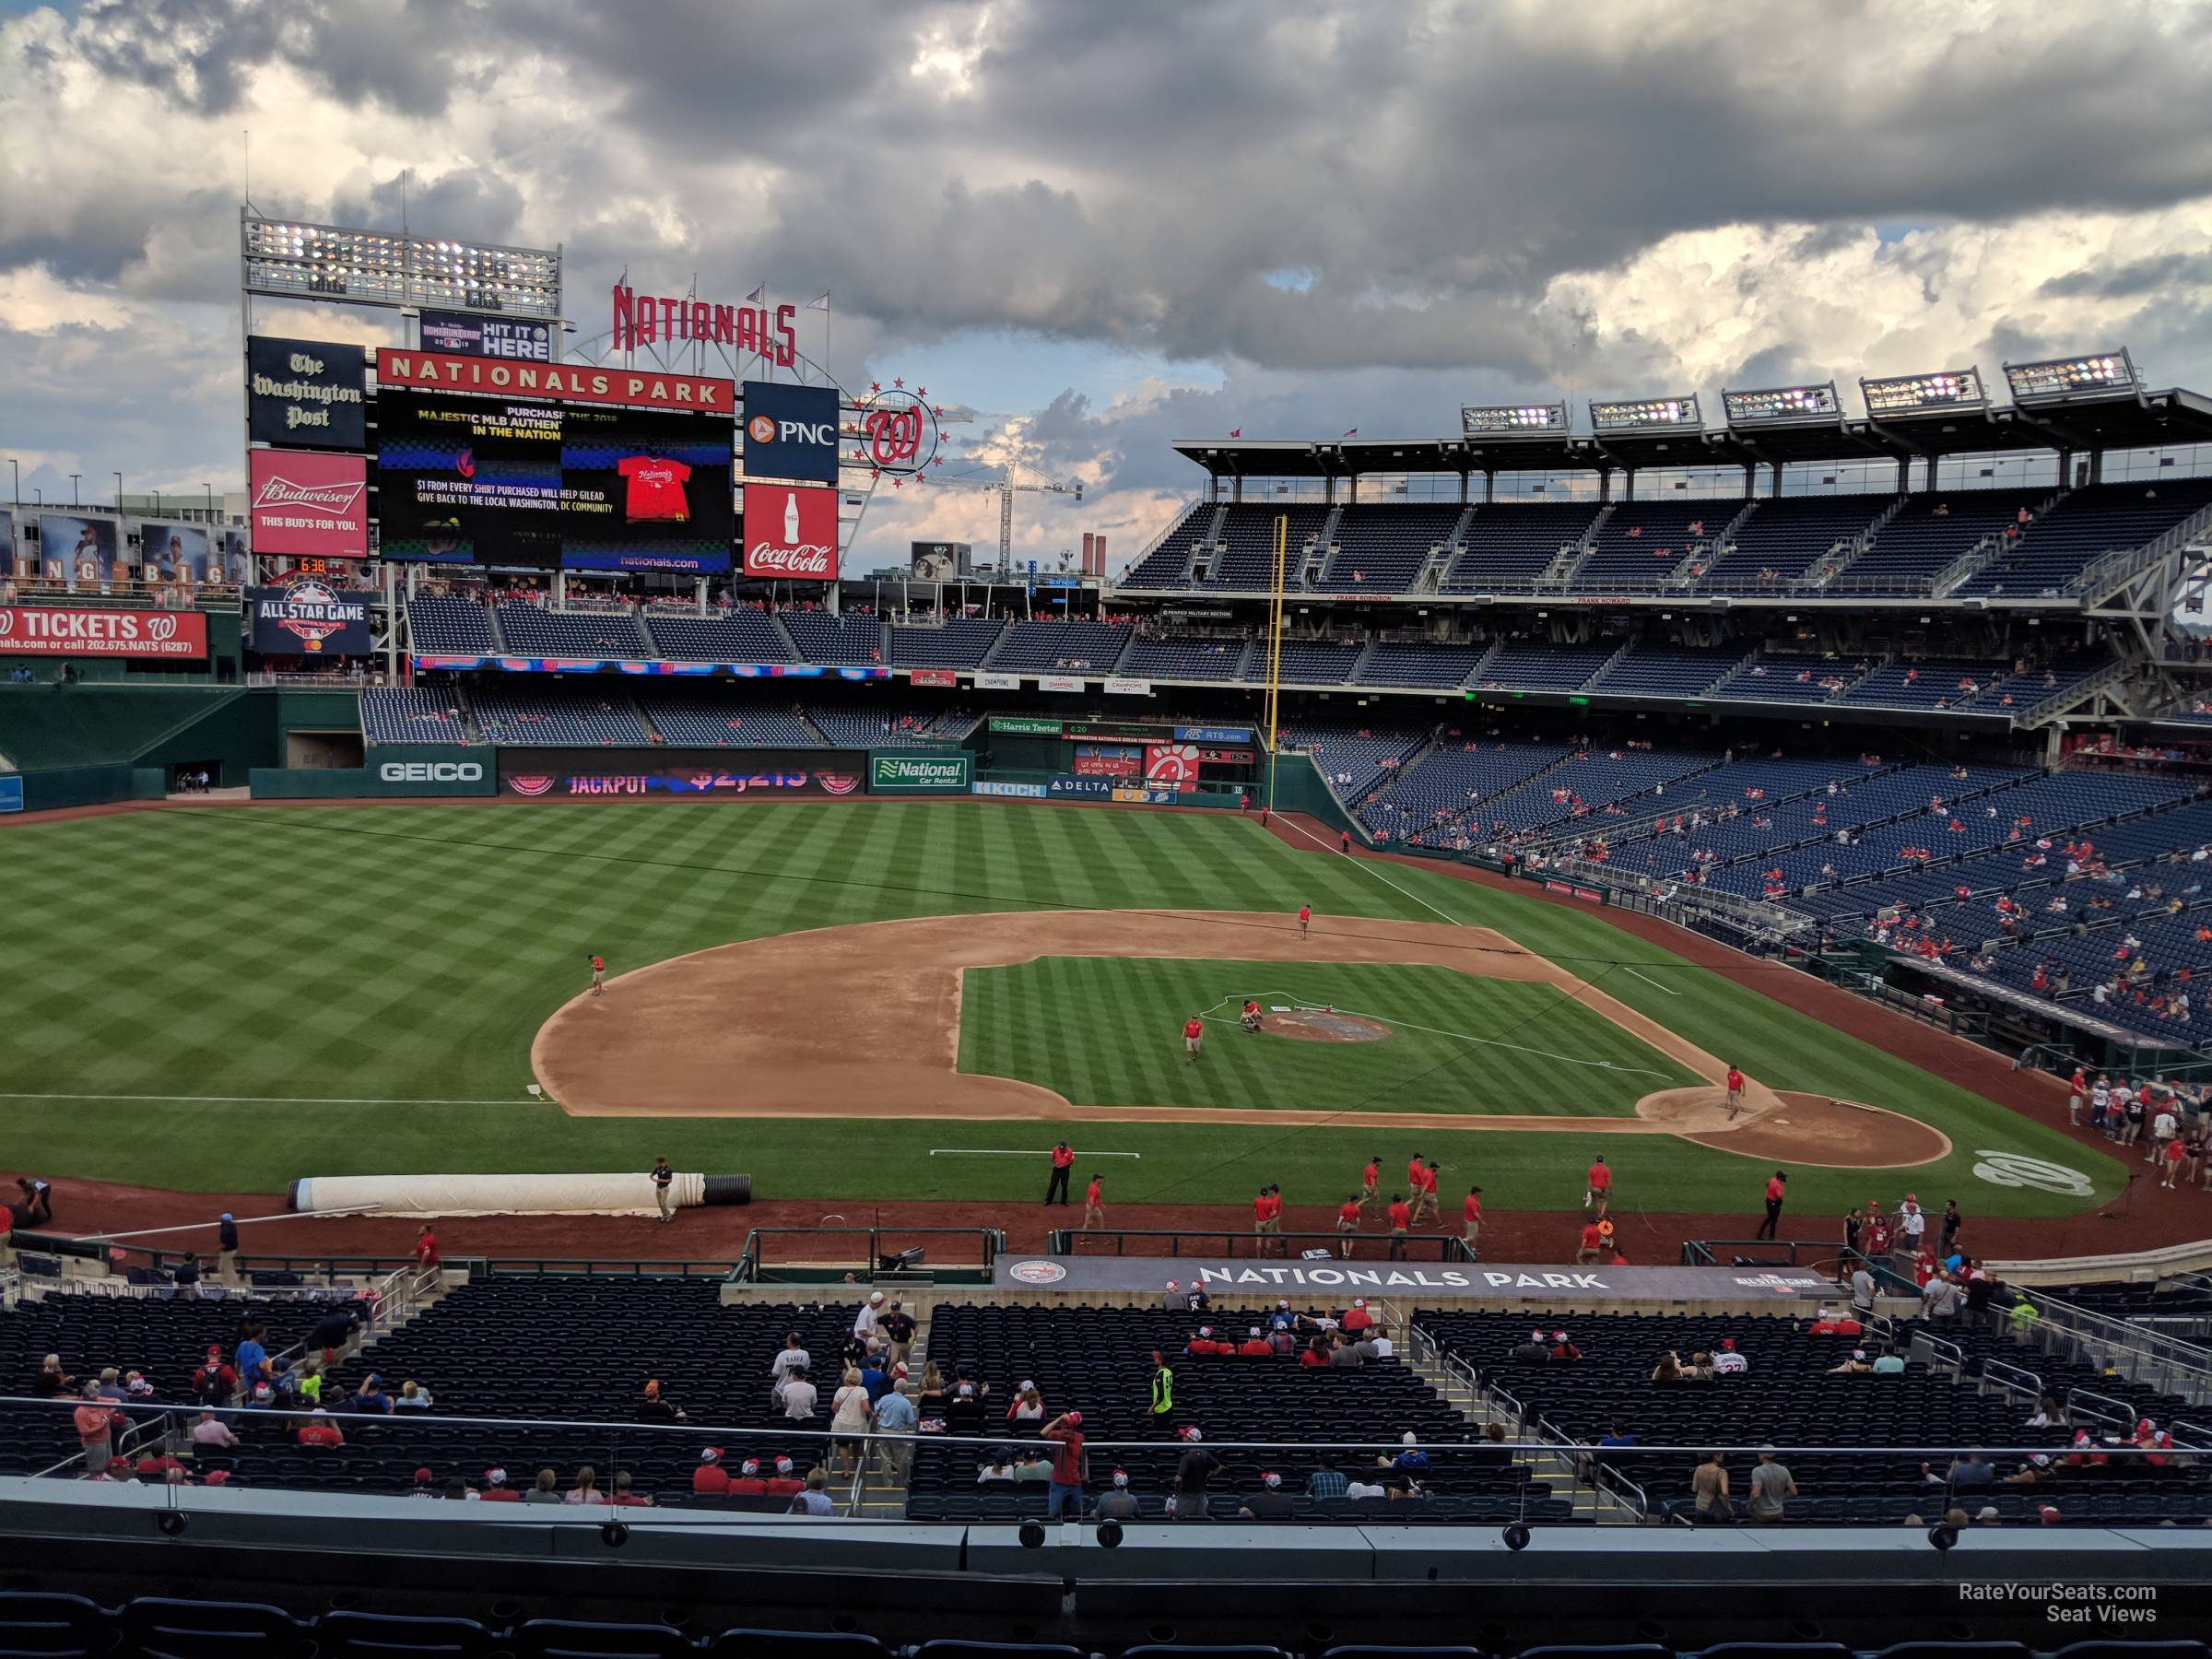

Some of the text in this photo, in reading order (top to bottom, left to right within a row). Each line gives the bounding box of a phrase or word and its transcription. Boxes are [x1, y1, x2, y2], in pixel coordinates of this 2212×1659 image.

[483, 323, 532, 339] HIT IT
[613, 285, 796, 368] NATIONALS
[483, 336, 548, 360] HERE
[289, 353, 325, 376] The
[253, 372, 363, 406] Washington
[392, 357, 717, 405] NATIONALS PARK
[287, 406, 330, 429] Post
[418, 409, 479, 424] MAJESTIC
[482, 415, 508, 427] MLB
[473, 425, 487, 436] IN
[488, 427, 512, 438] THE
[778, 420, 835, 447] PNC
[262, 482, 353, 503] Budweiser
[417, 480, 605, 501] $1 FROM EVERY SHIRT PURCHASED WILL HELP GILEAD
[417, 492, 613, 513] GIVE BACK TO THE LOCAL WASHINGTON, DC COMMUNITY
[261, 516, 359, 531] THIS BUD'S FOR YOU.
[620, 557, 699, 569] nationals.com
[749, 541, 833, 572] Coca-Cola
[260, 602, 365, 620] ALL STAR GAME
[22, 612, 139, 639] TICKETS
[49, 641, 62, 650] or
[65, 640, 85, 650] call
[88, 640, 158, 652] 202.675.NATS
[160, 641, 193, 653] (6287)
[1003, 722, 1060, 733] Harris Teeter
[380, 762, 483, 782] GEICO
[898, 762, 960, 777] National
[570, 775, 649, 794] JACKPOT
[993, 783, 1041, 796] KOCH
[1065, 781, 1109, 792] DELTA
[2130, 1105, 2141, 1114] 34
[1198, 1267, 1610, 1289] NATIONALS PARK
